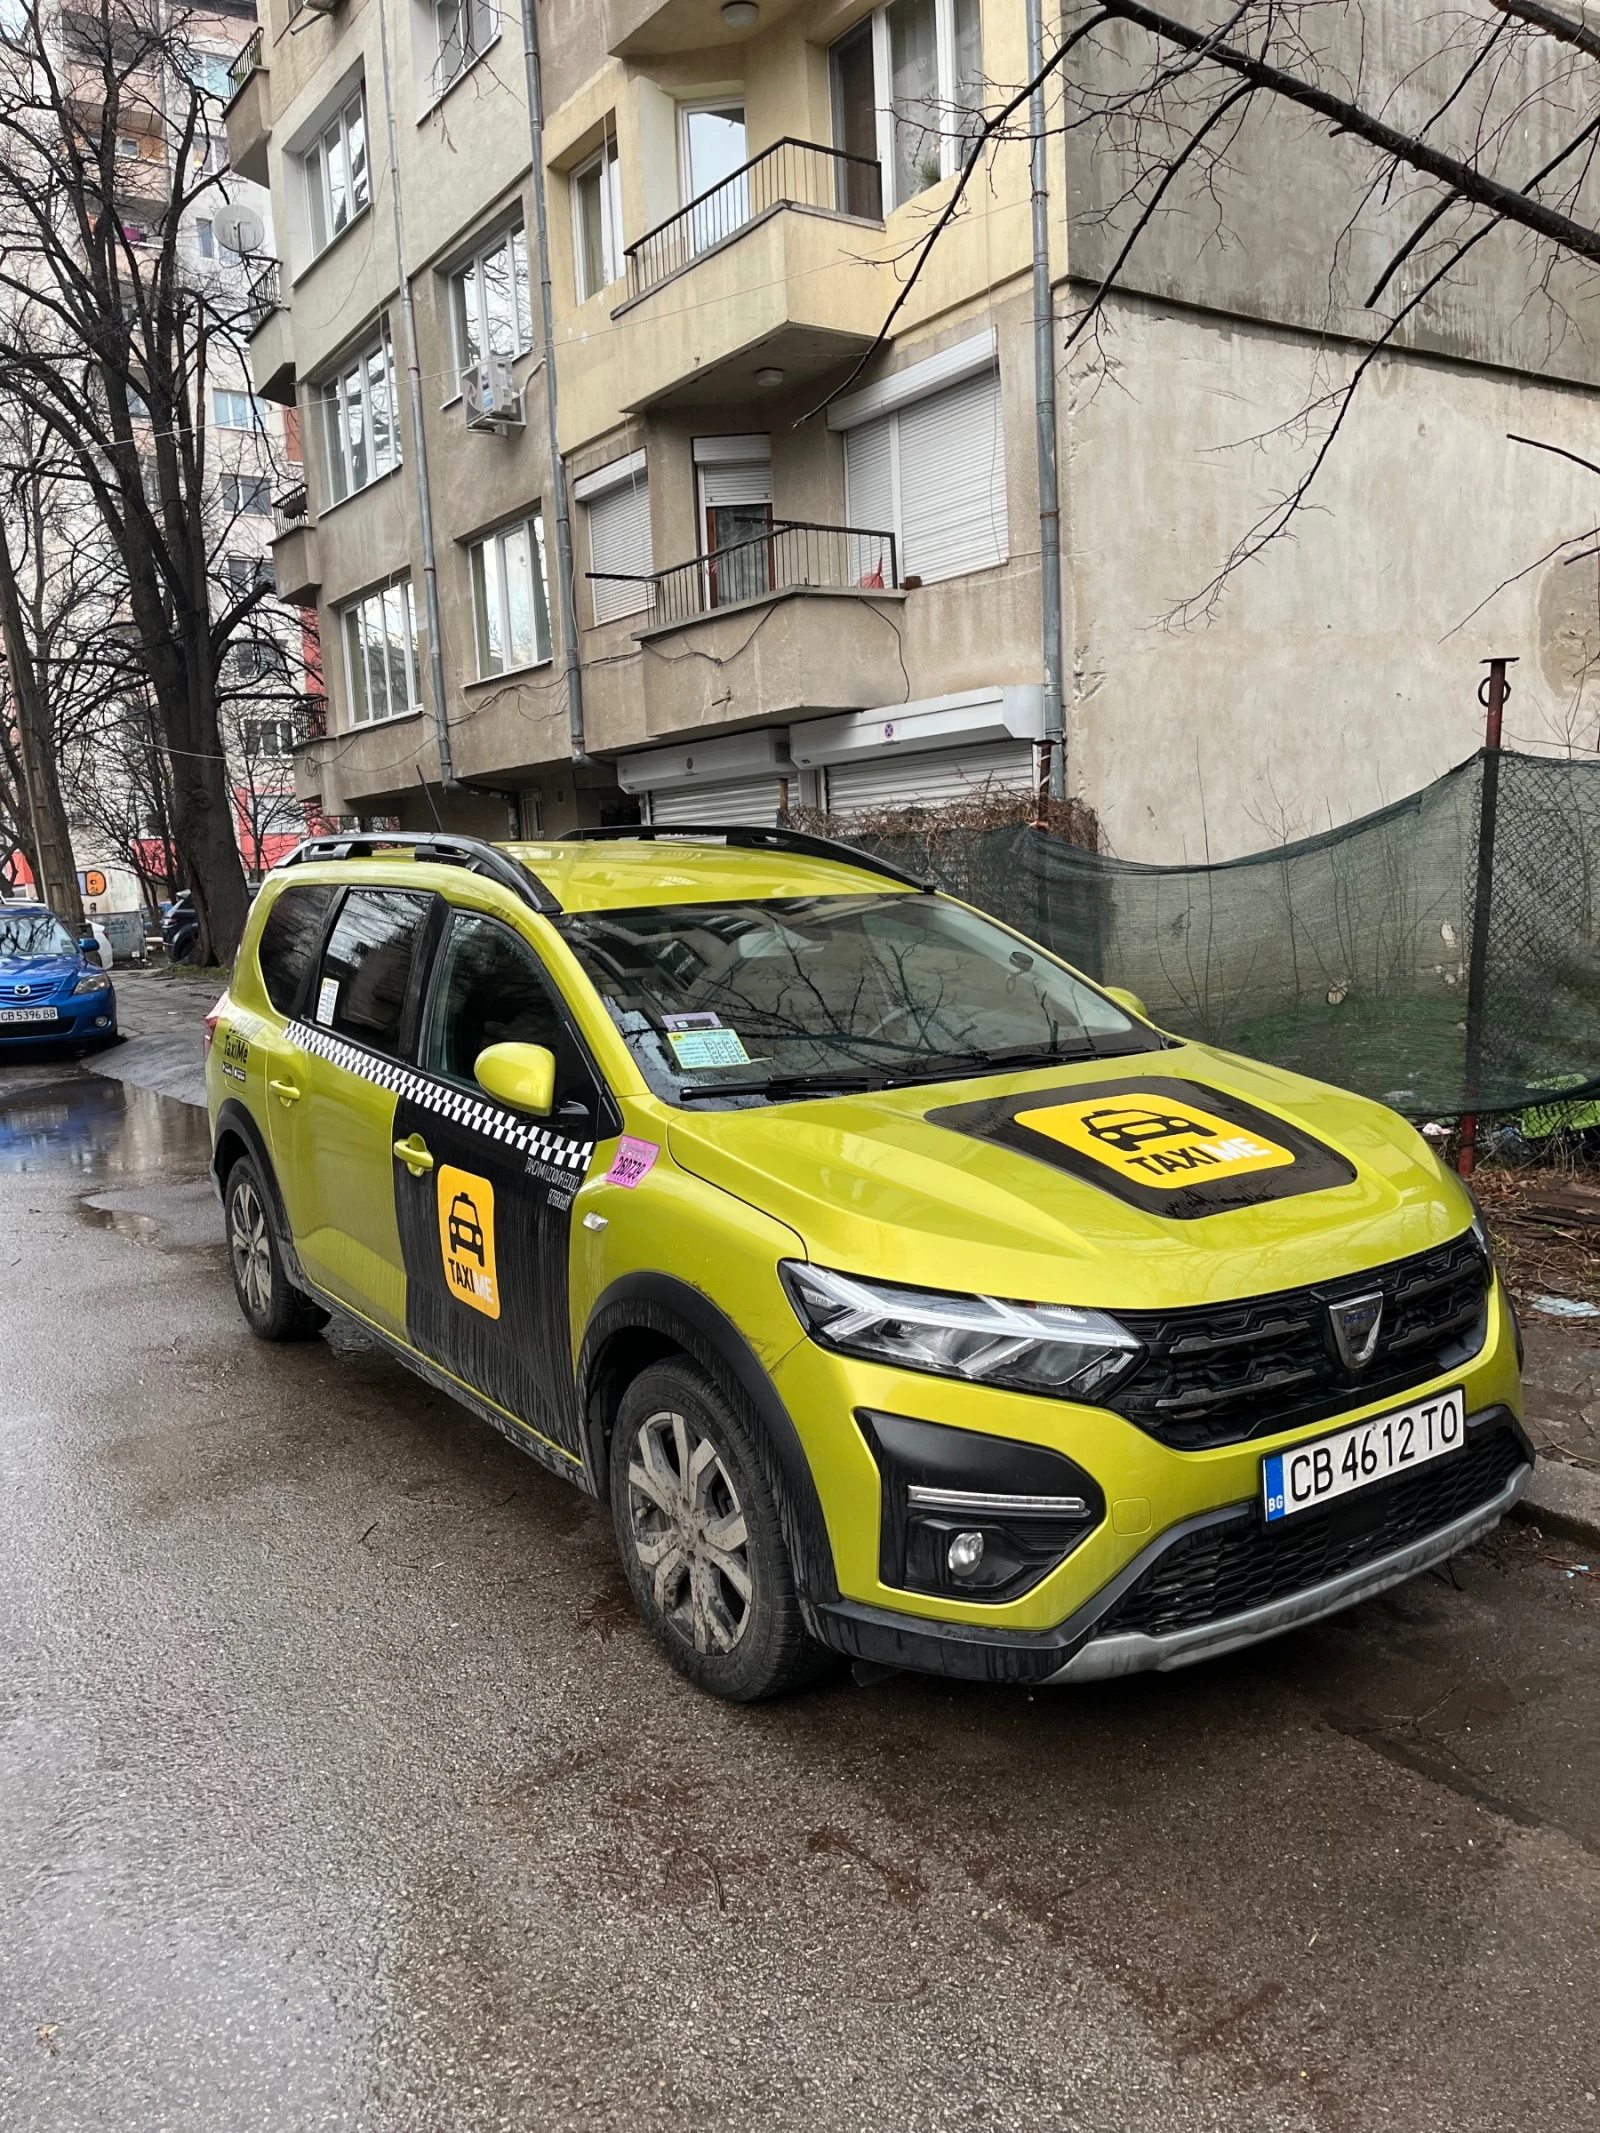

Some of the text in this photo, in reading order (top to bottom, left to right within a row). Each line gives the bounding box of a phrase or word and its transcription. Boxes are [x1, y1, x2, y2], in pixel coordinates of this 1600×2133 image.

[1, 1009, 56, 1021] CB 5396 BB
[224, 1035, 248, 1064] TaxiMe
[612, 1155, 646, 1180] 260739
[1124, 1137, 1272, 1175] TAXIME
[448, 1257, 494, 1304] TAXIME
[1290, 1401, 1458, 1502] CB 4612 TO
[1268, 1495, 1284, 1512] BG
